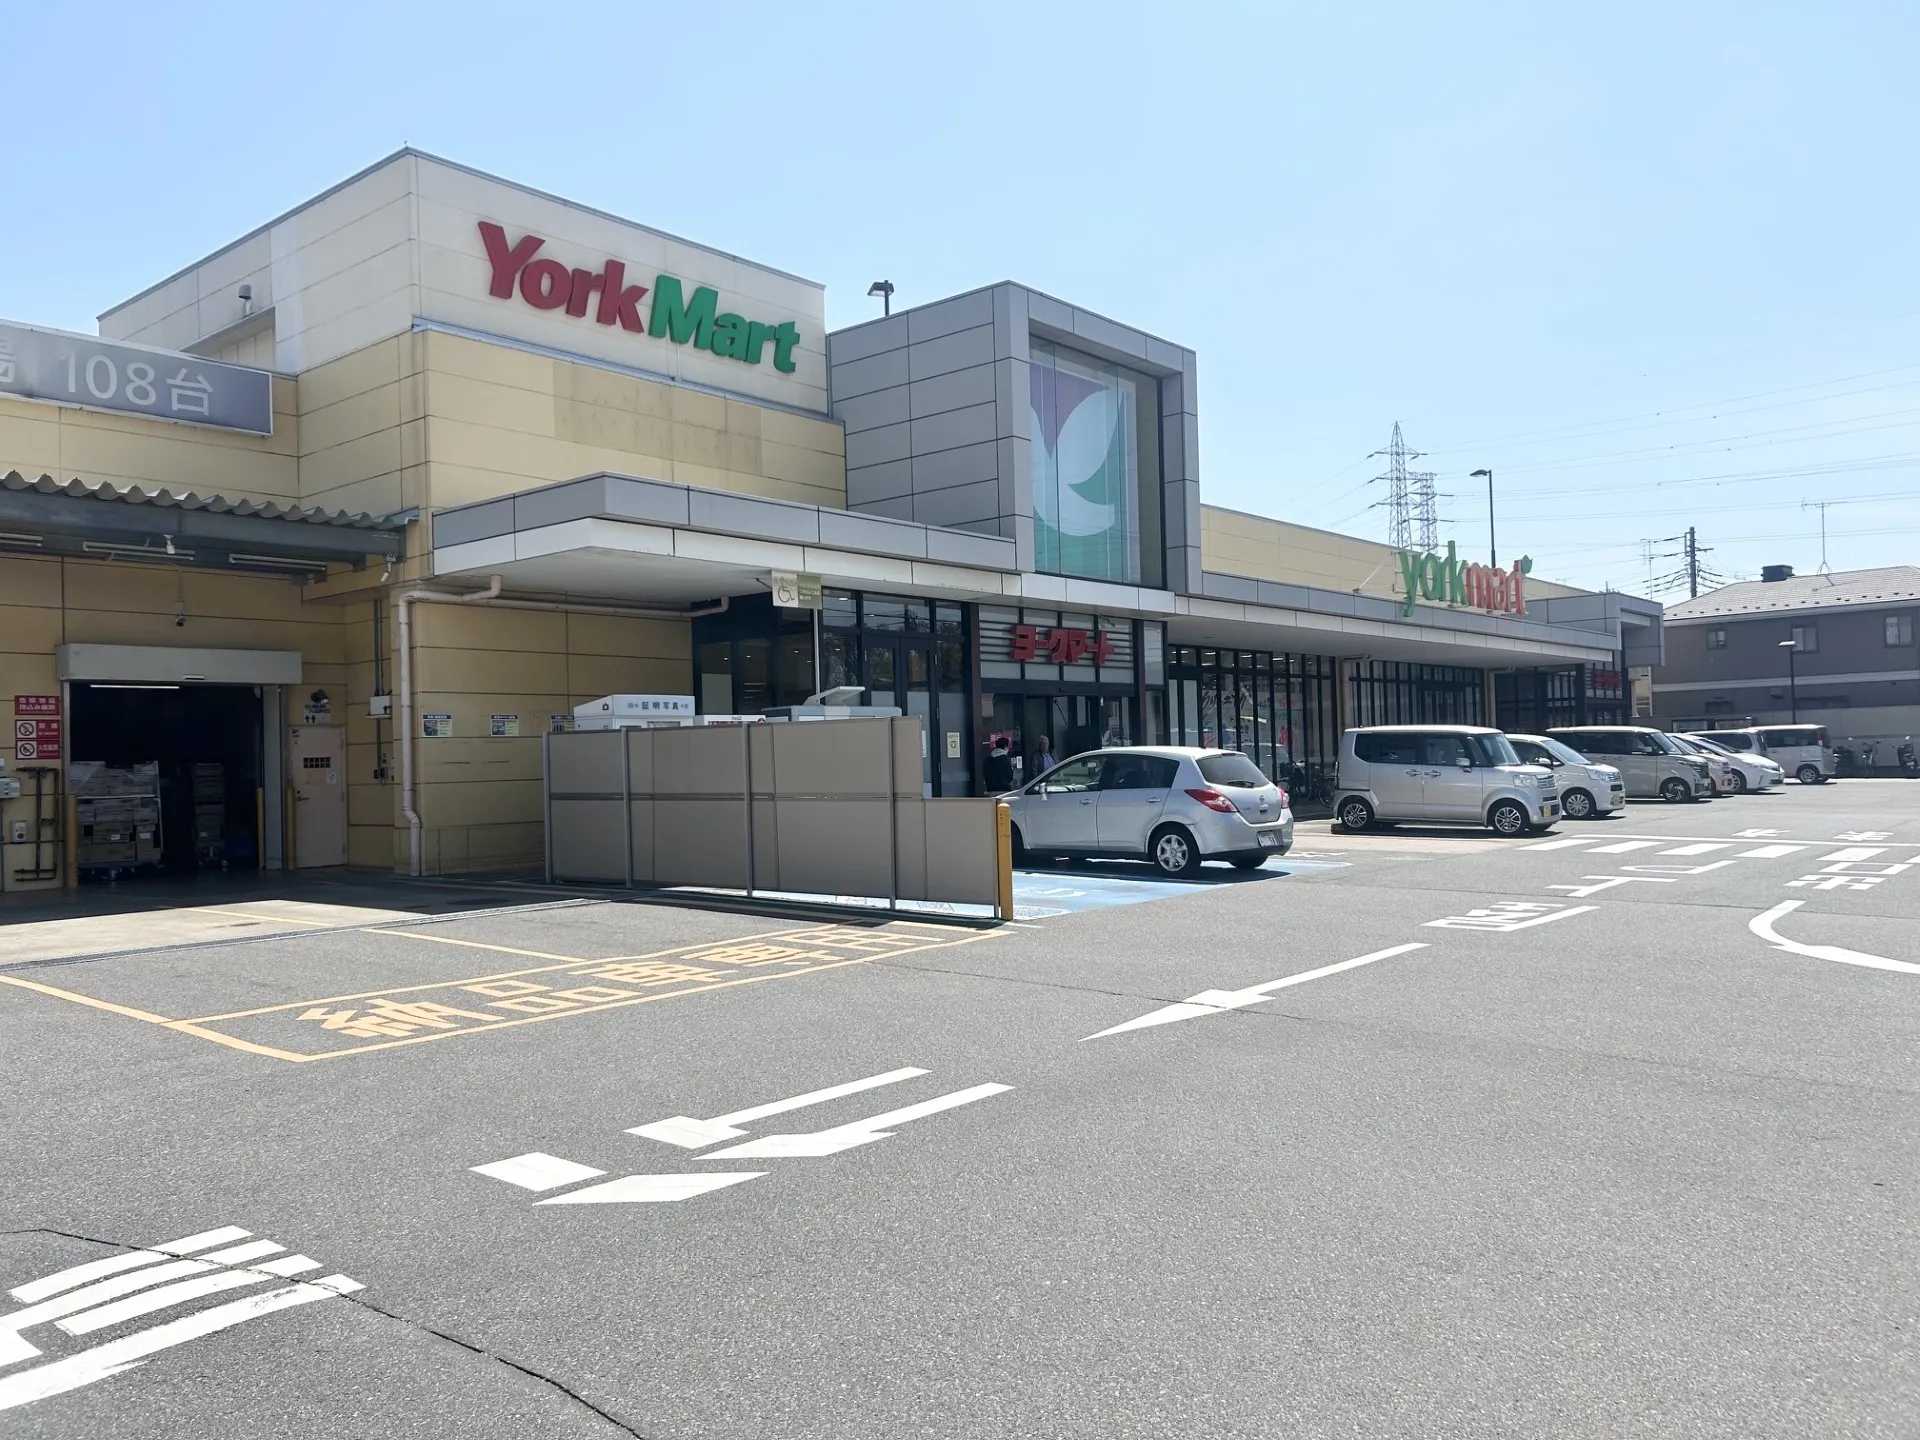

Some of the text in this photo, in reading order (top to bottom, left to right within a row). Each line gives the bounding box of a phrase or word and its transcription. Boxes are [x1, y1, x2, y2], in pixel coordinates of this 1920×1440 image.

[1009, 625, 1116, 664] ヨークマート
[641, 701, 679, 711] 証明写真
